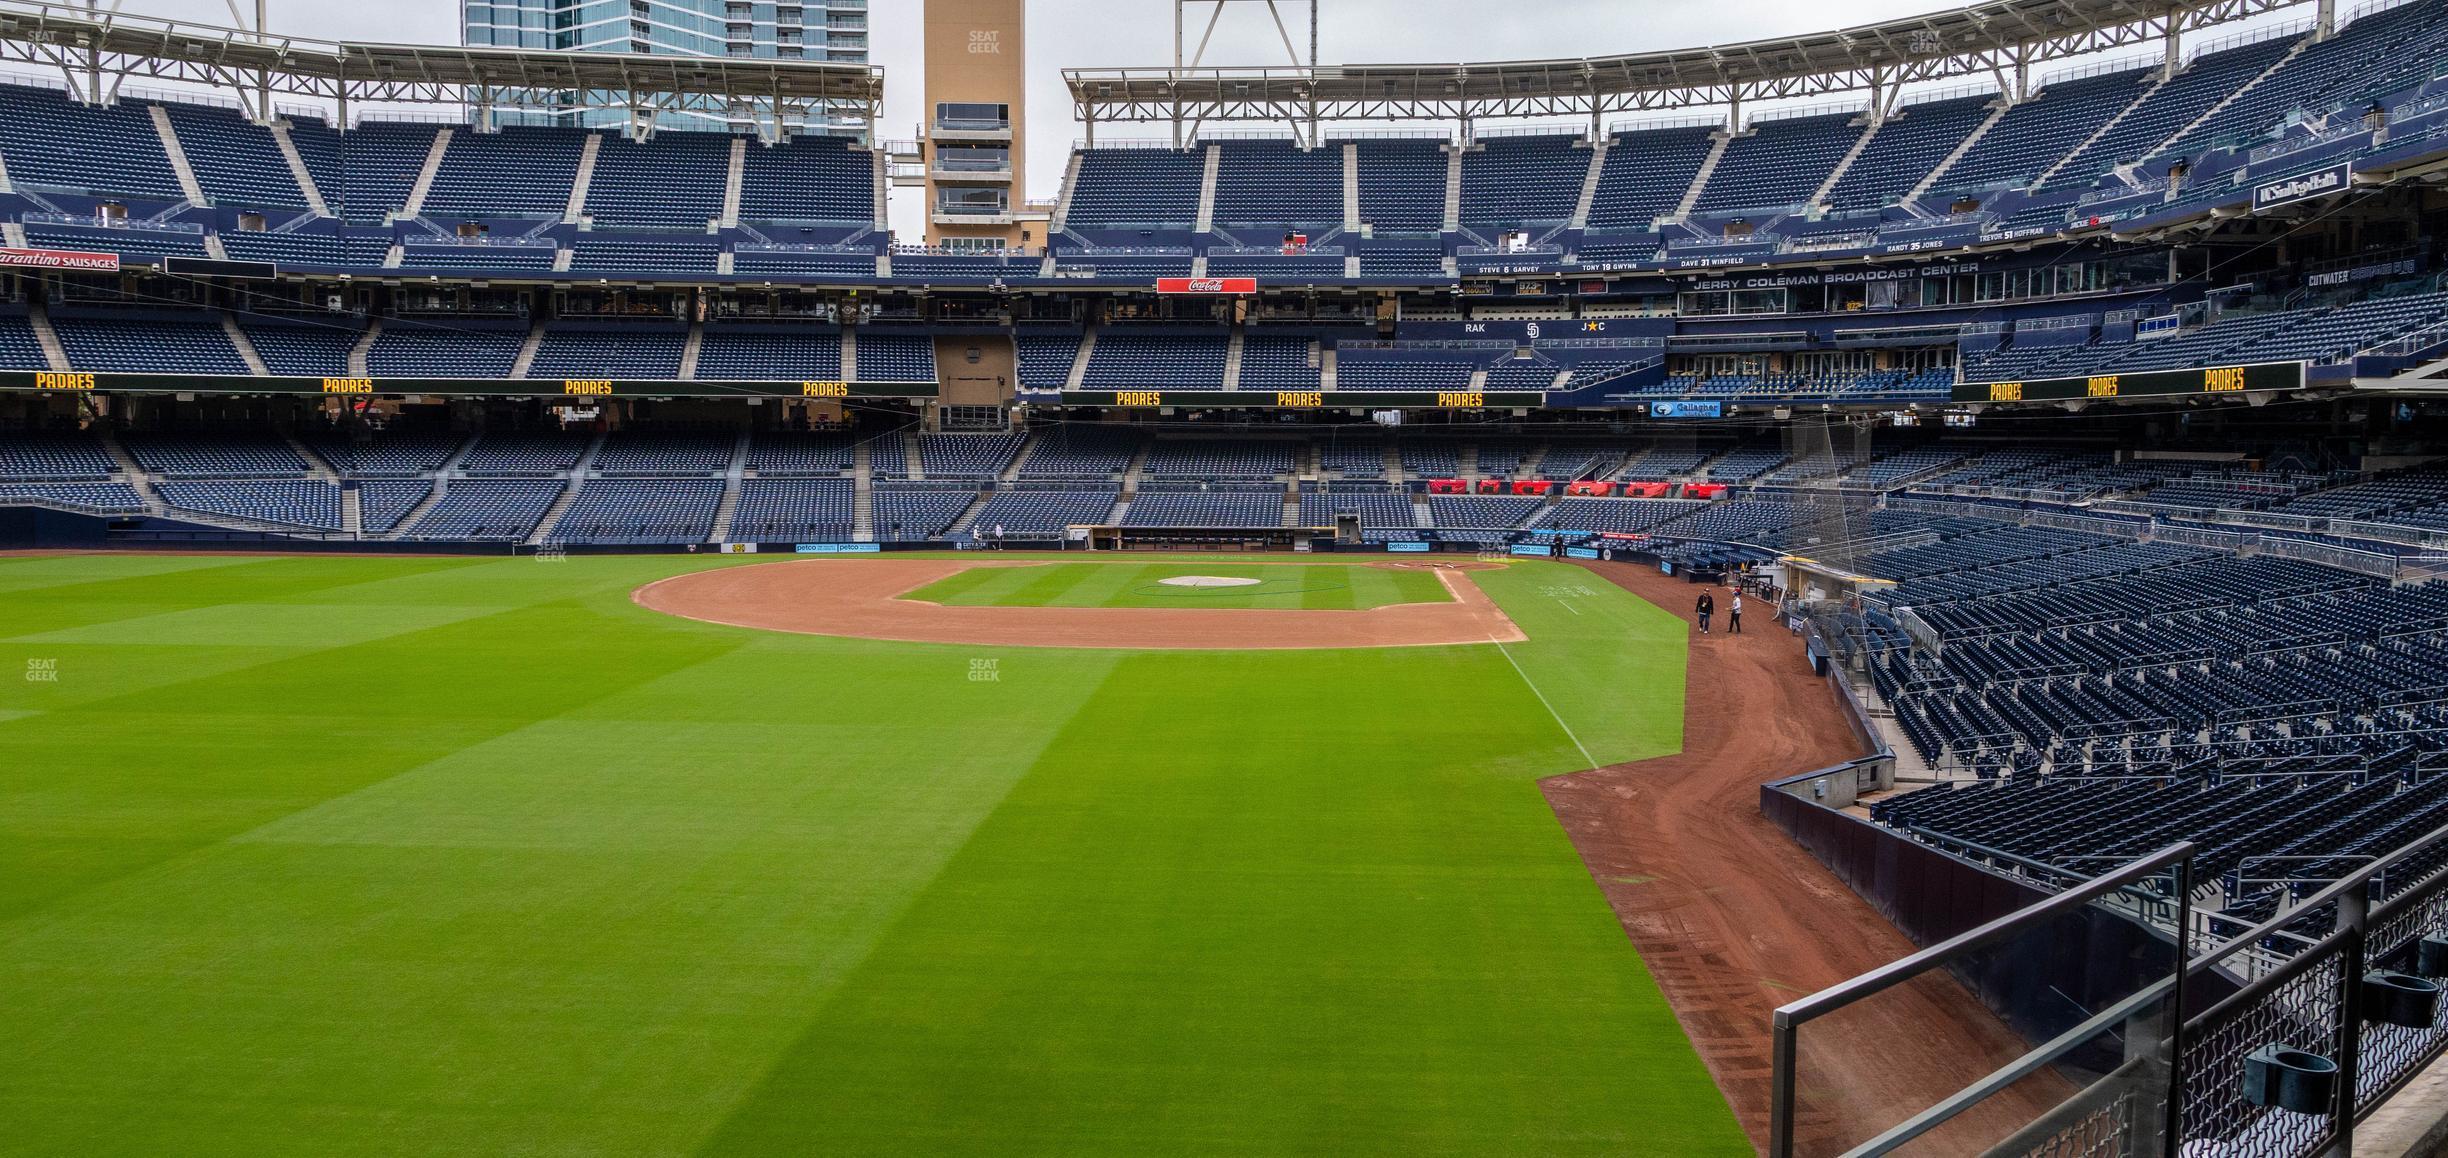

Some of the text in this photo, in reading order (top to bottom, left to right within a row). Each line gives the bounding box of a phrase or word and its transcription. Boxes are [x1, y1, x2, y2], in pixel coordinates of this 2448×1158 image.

[1979, 227, 2044, 243] TREVOR 51 HOFFMAN
[1887, 240, 1943, 252] RANDY 35 JONES
[0, 252, 117, 269] arantino SAUSAGES
[1602, 263, 1611, 271] 19
[1613, 262, 1637, 270] GWYNN
[1681, 257, 1744, 267] DAVE 31 WINFIELD
[1479, 265, 1539, 274] STEVE 6 GARVEY
[1693, 262, 1979, 290] JERRY COLEMAN BROADCAST CENTER
[2308, 270, 2349, 287] CUTWATER
[1465, 323, 1485, 333] RAK
[36, 371, 95, 390] PADRES
[323, 377, 373, 394] PADRES
[565, 379, 612, 395] PADRES
[2088, 376, 2118, 397] PADRES
[2204, 367, 2244, 392] PADRES
[803, 381, 848, 397] PADRES
[1990, 383, 2022, 401] PADRES
[1117, 391, 1159, 406] PADRES
[1278, 391, 1322, 407] PADRES
[1438, 392, 1483, 407] PADRES
[1676, 402, 1719, 412] Gallagher
[796, 544, 817, 552] petco
[1512, 544, 1531, 552] petco
[1567, 547, 1583, 556] petco
